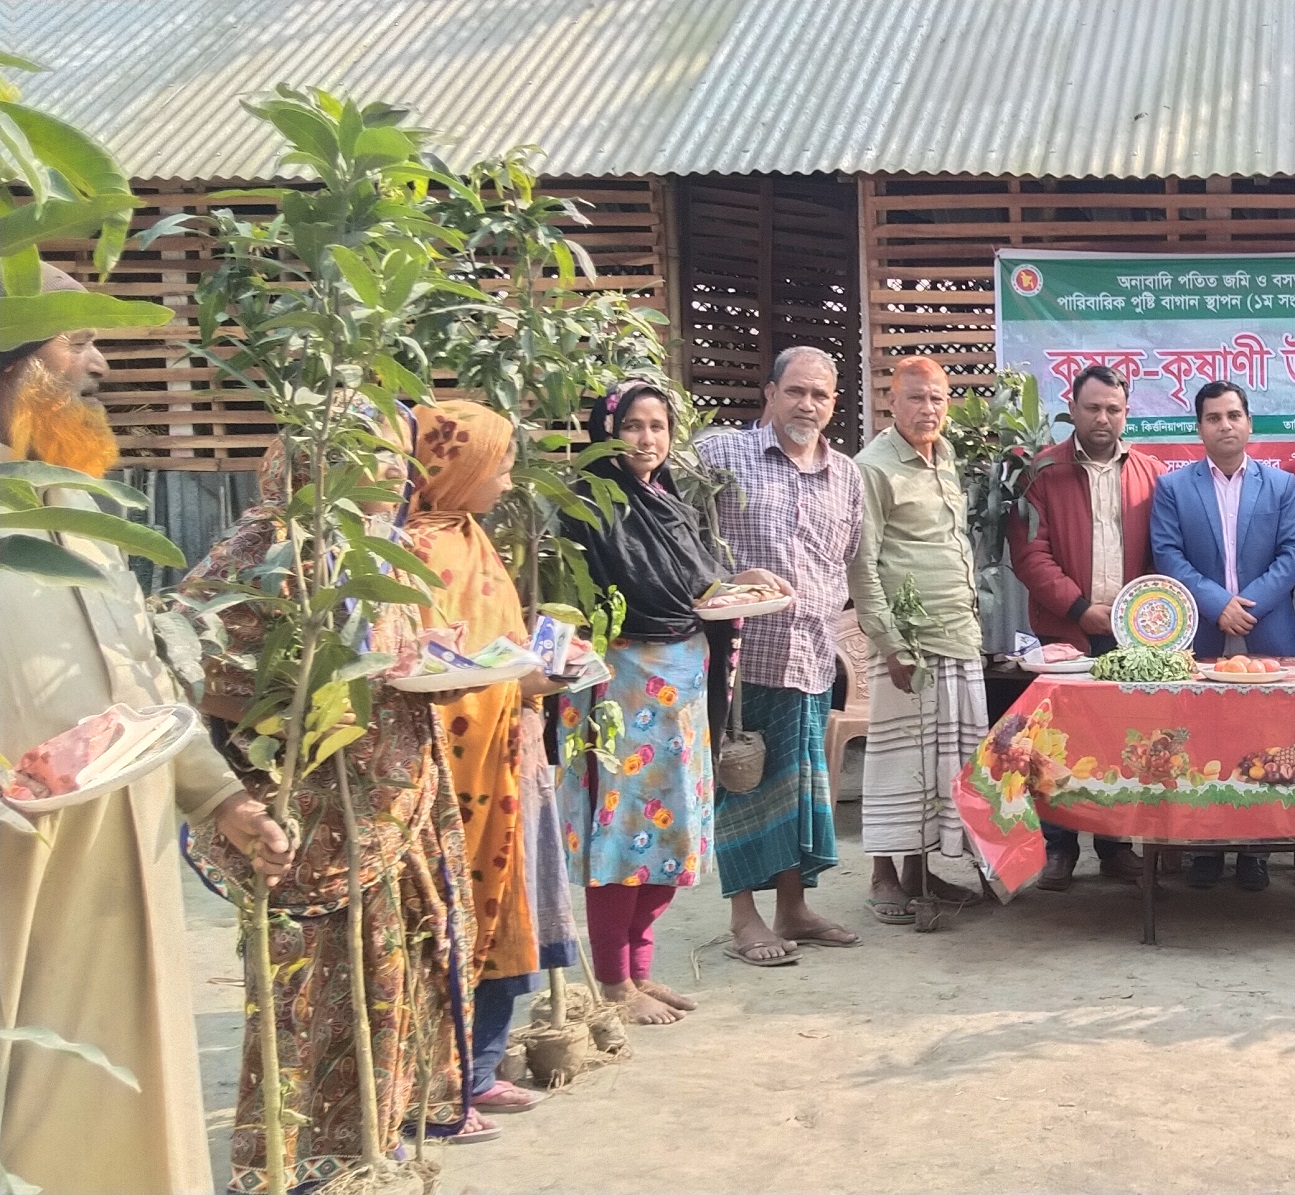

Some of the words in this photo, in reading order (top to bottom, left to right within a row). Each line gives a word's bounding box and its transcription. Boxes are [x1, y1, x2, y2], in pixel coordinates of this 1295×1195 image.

[1116, 271, 1173, 290] অনাবাদি
[1178, 270, 1219, 288] পতিত
[1222, 270, 1251, 289] জমি
[1255, 274, 1267, 287] ও
[1057, 292, 1126, 311] পারিবারিক
[1130, 291, 1156, 315] পুষ্টি
[1160, 295, 1200, 311] বাগান
[1203, 295, 1242, 313] স্থাপন
[1246, 292, 1274, 313] (১ম
